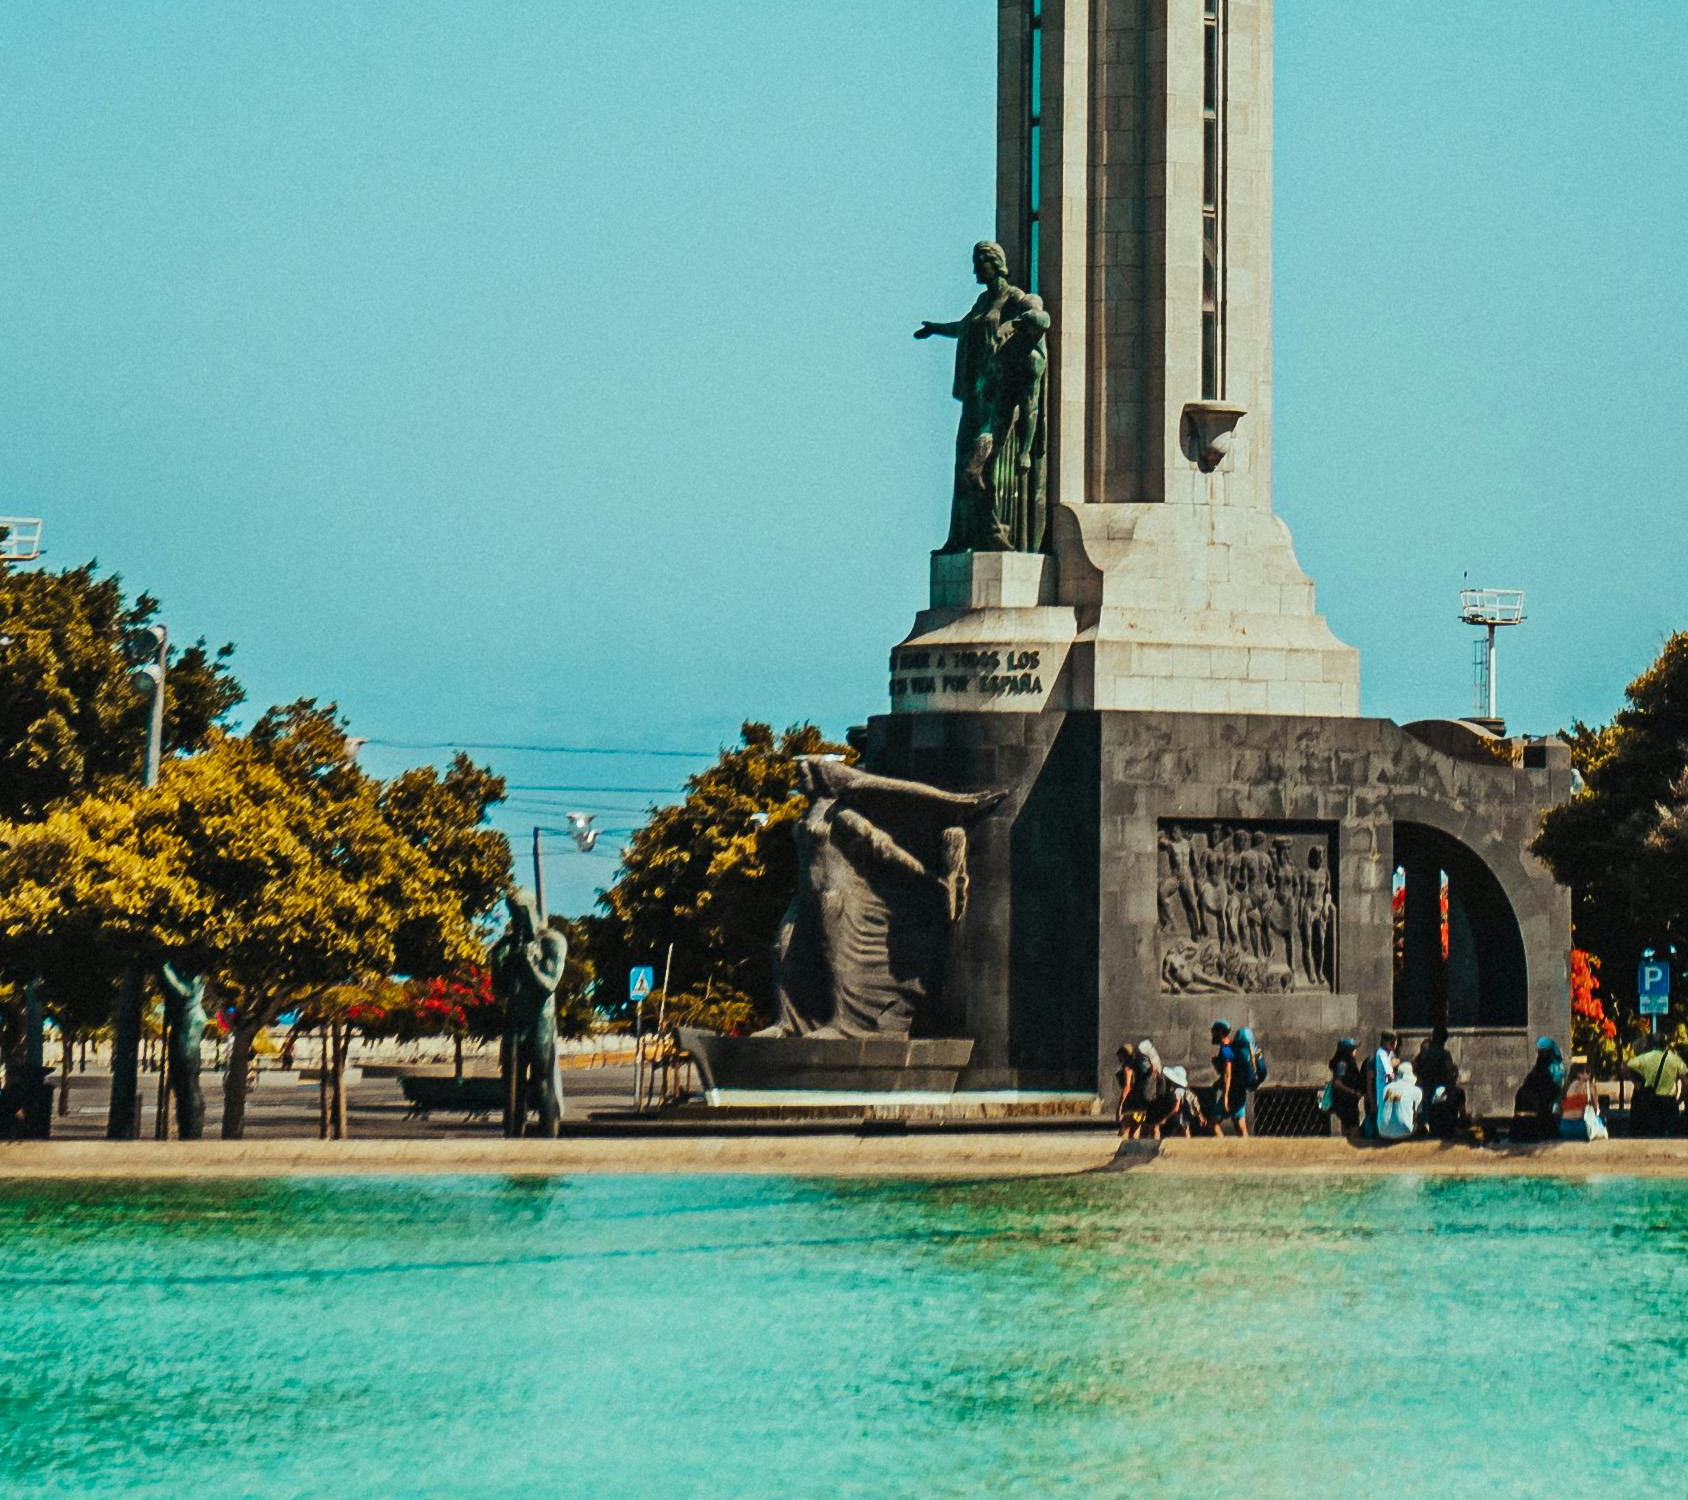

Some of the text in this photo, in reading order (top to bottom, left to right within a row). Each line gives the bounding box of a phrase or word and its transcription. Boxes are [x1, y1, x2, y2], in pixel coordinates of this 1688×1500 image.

[1008, 650, 1041, 672] LOS
[979, 672, 1044, 696] ESPAÑA
[1645, 966, 1662, 990] P
